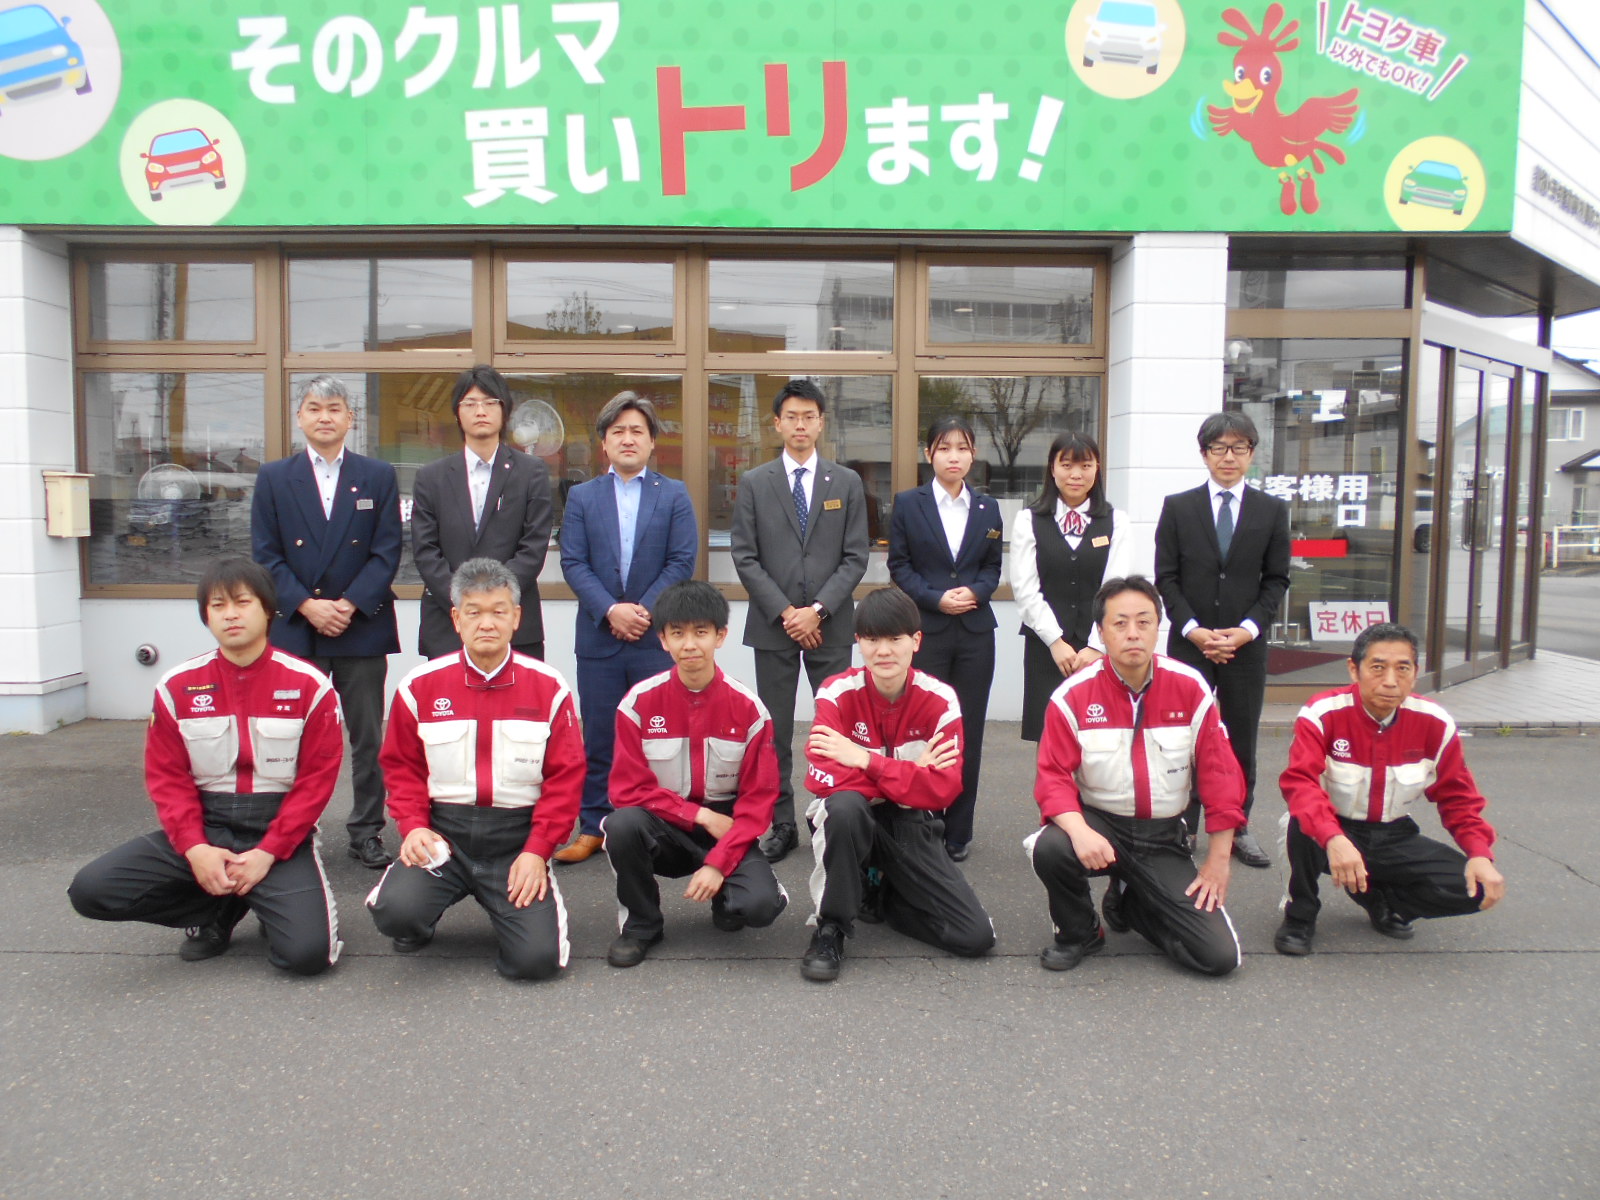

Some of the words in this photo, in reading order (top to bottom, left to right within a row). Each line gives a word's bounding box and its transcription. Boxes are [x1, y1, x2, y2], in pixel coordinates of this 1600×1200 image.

[1339, 3, 1443, 63] トヨタ車
[231, 3, 620, 103] そのクルマ
[1317, 610, 1385, 634] 定休日
[1085, 716, 1108, 724] TOYOTA
[851, 730, 871, 743] TOYOTA
[808, 761, 834, 788] OTA
